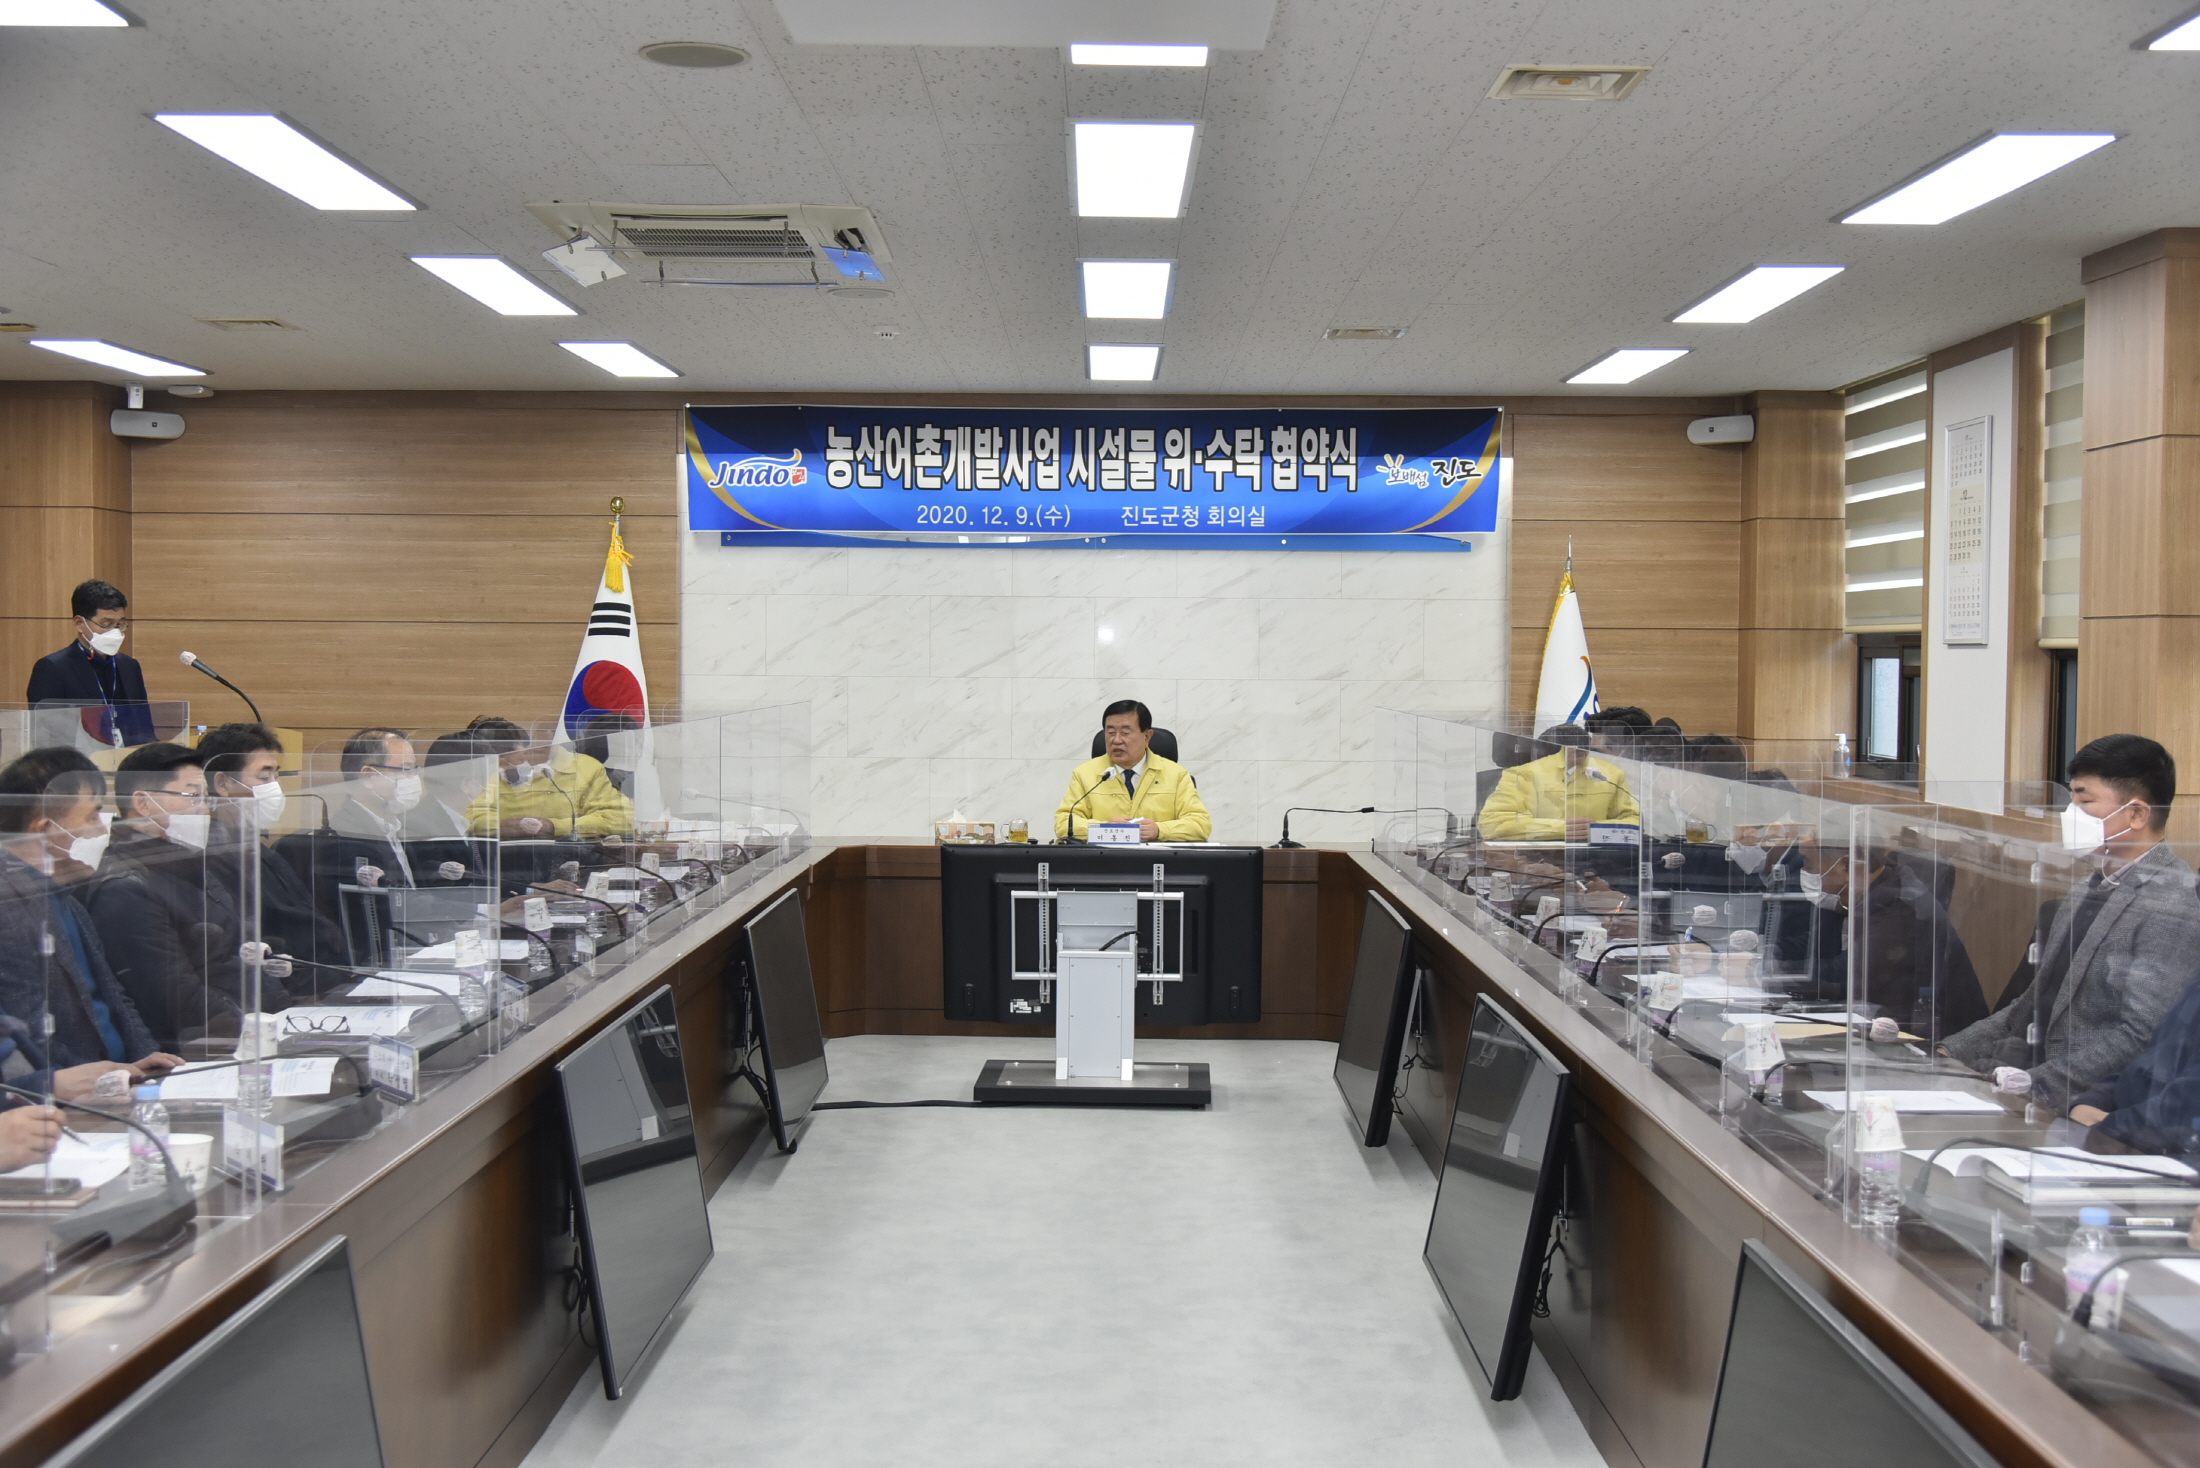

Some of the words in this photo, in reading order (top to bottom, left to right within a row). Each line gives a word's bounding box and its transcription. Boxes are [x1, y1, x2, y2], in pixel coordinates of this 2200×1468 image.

[825, 424, 1060, 491] 농산어촌개발사업
[1067, 426, 1159, 492] 시설물
[1163, 426, 1265, 492] 위·수탁
[1271, 425, 1361, 492] 협약식
[709, 462, 790, 488] Jindo
[1387, 467, 1428, 488] 보배섬
[1432, 458, 1483, 487] 진도
[916, 505, 974, 526] 2020.
[982, 506, 1009, 526] 12.
[1121, 505, 1200, 528] 진도군청
[1207, 505, 1266, 528] 회의실
